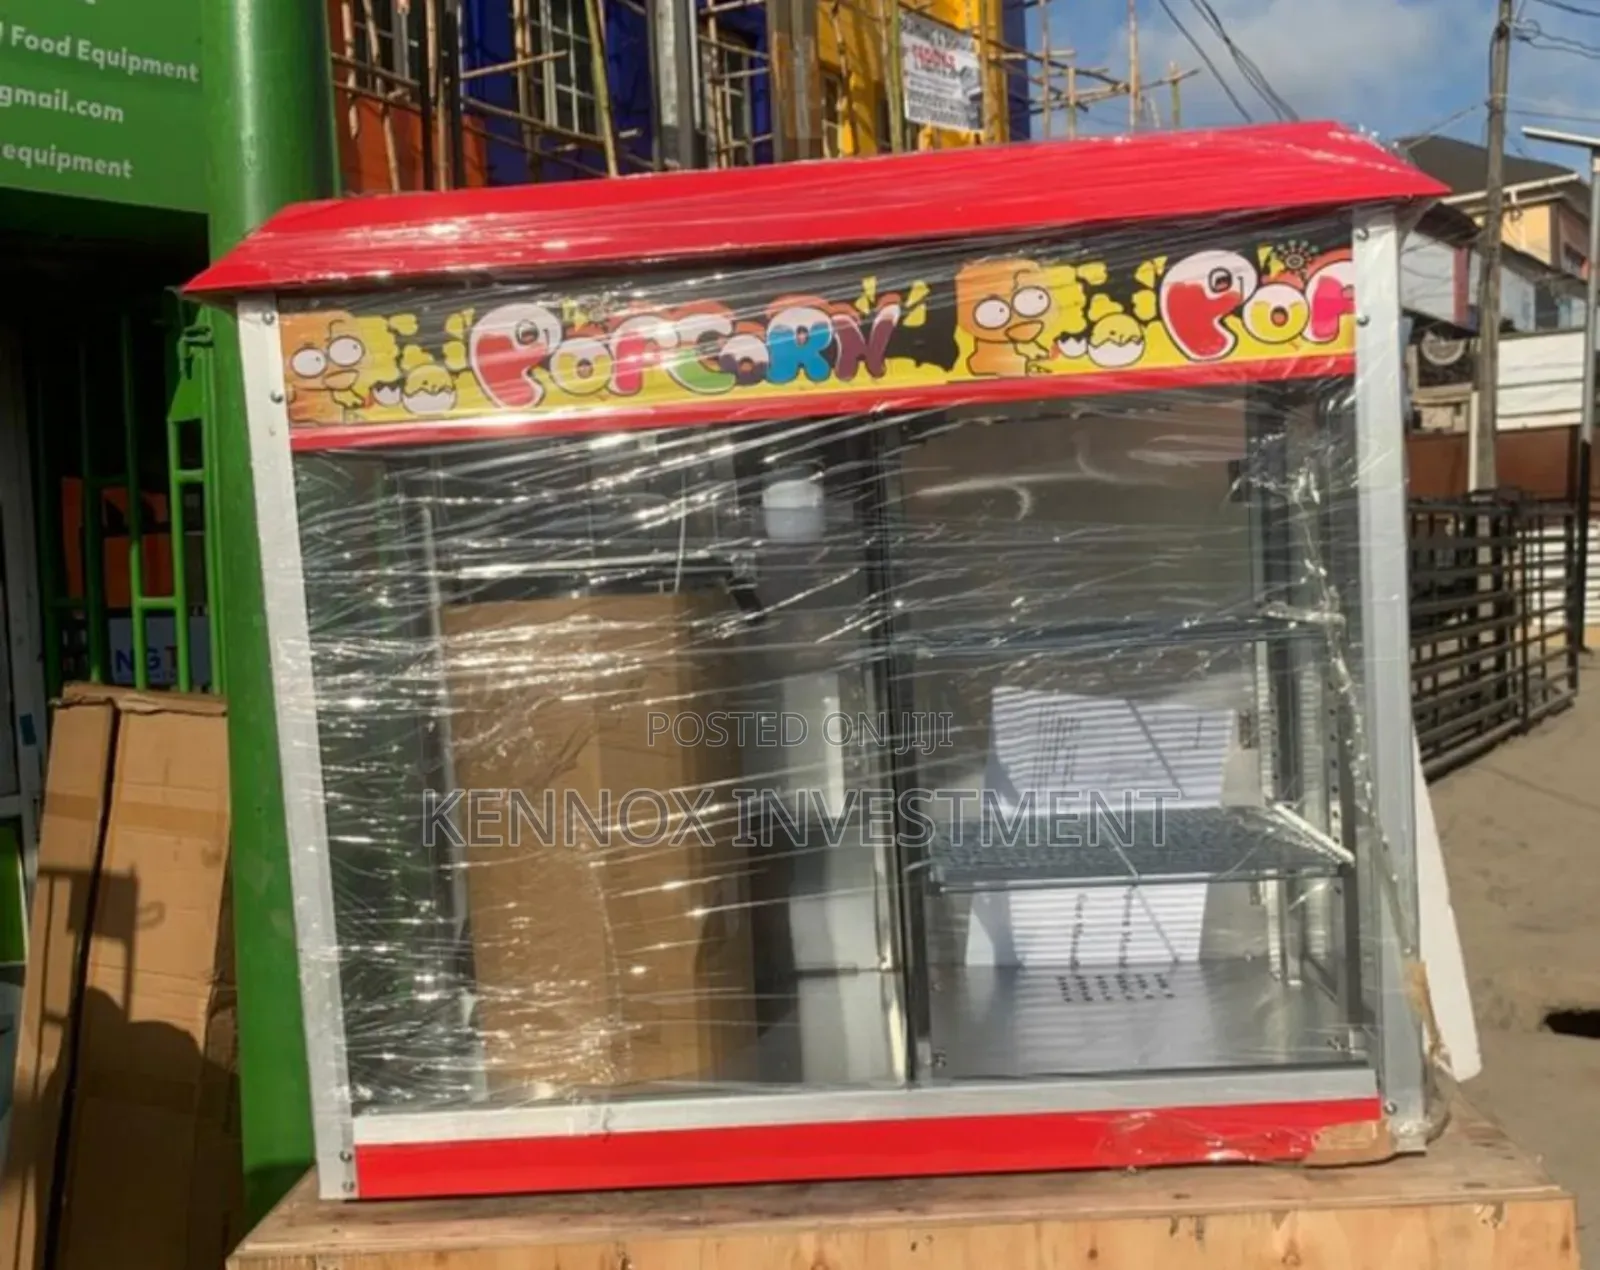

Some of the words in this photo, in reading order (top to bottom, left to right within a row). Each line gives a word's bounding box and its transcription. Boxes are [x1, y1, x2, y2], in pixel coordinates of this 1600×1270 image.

[11, 25, 72, 57] Food
[77, 39, 199, 82] Equipment
[3, 144, 133, 178] equipment
